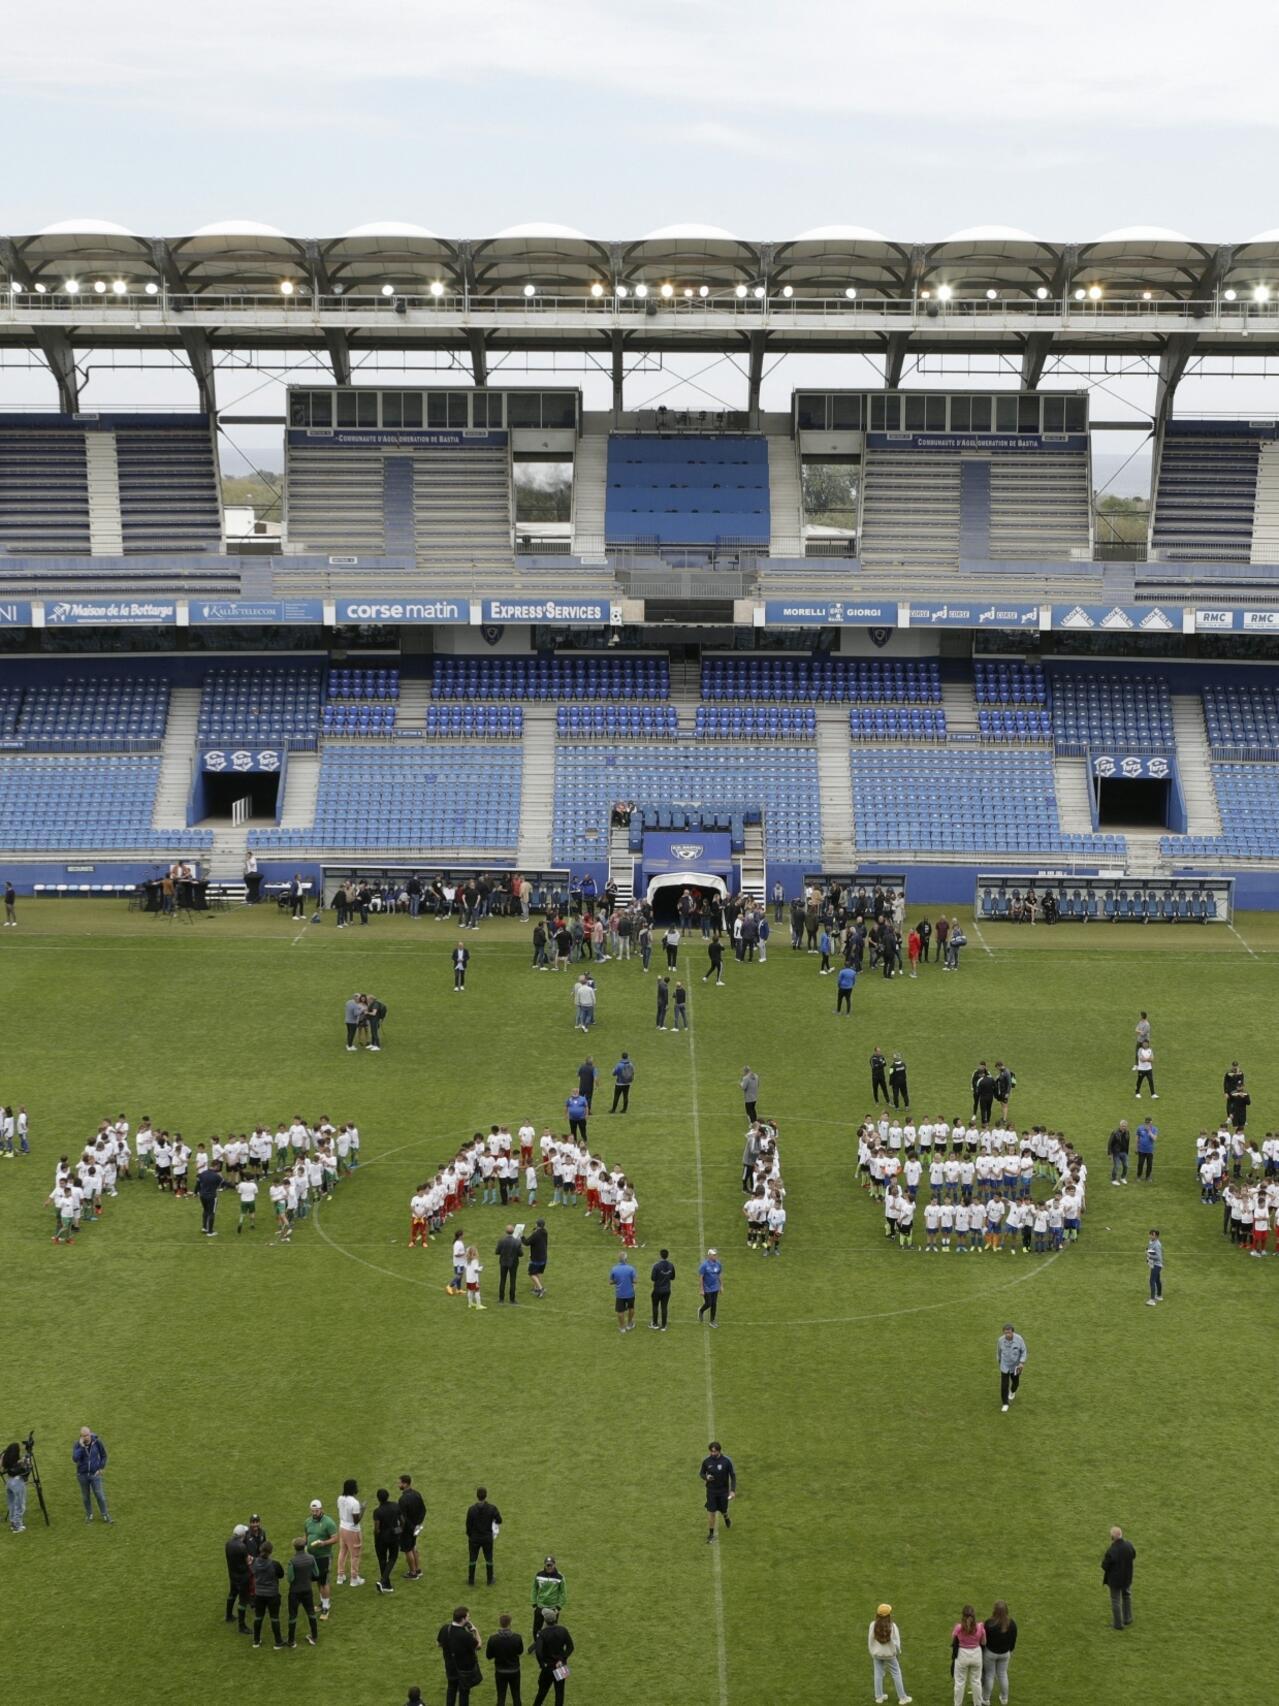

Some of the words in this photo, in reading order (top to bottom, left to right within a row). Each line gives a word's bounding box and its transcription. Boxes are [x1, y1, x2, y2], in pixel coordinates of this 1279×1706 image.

[71, 603, 106, 616] Maison
[107, 603, 119, 616] de
[120, 604, 129, 616] la
[131, 603, 173, 618] Bottarga
[347, 604, 403, 618] corse
[406, 601, 458, 618] matin
[783, 608, 825, 616] MORELLI
[847, 608, 881, 617] GIORGI
[1203, 613, 1226, 622] RMC
[1251, 614, 1274, 623] RMC
